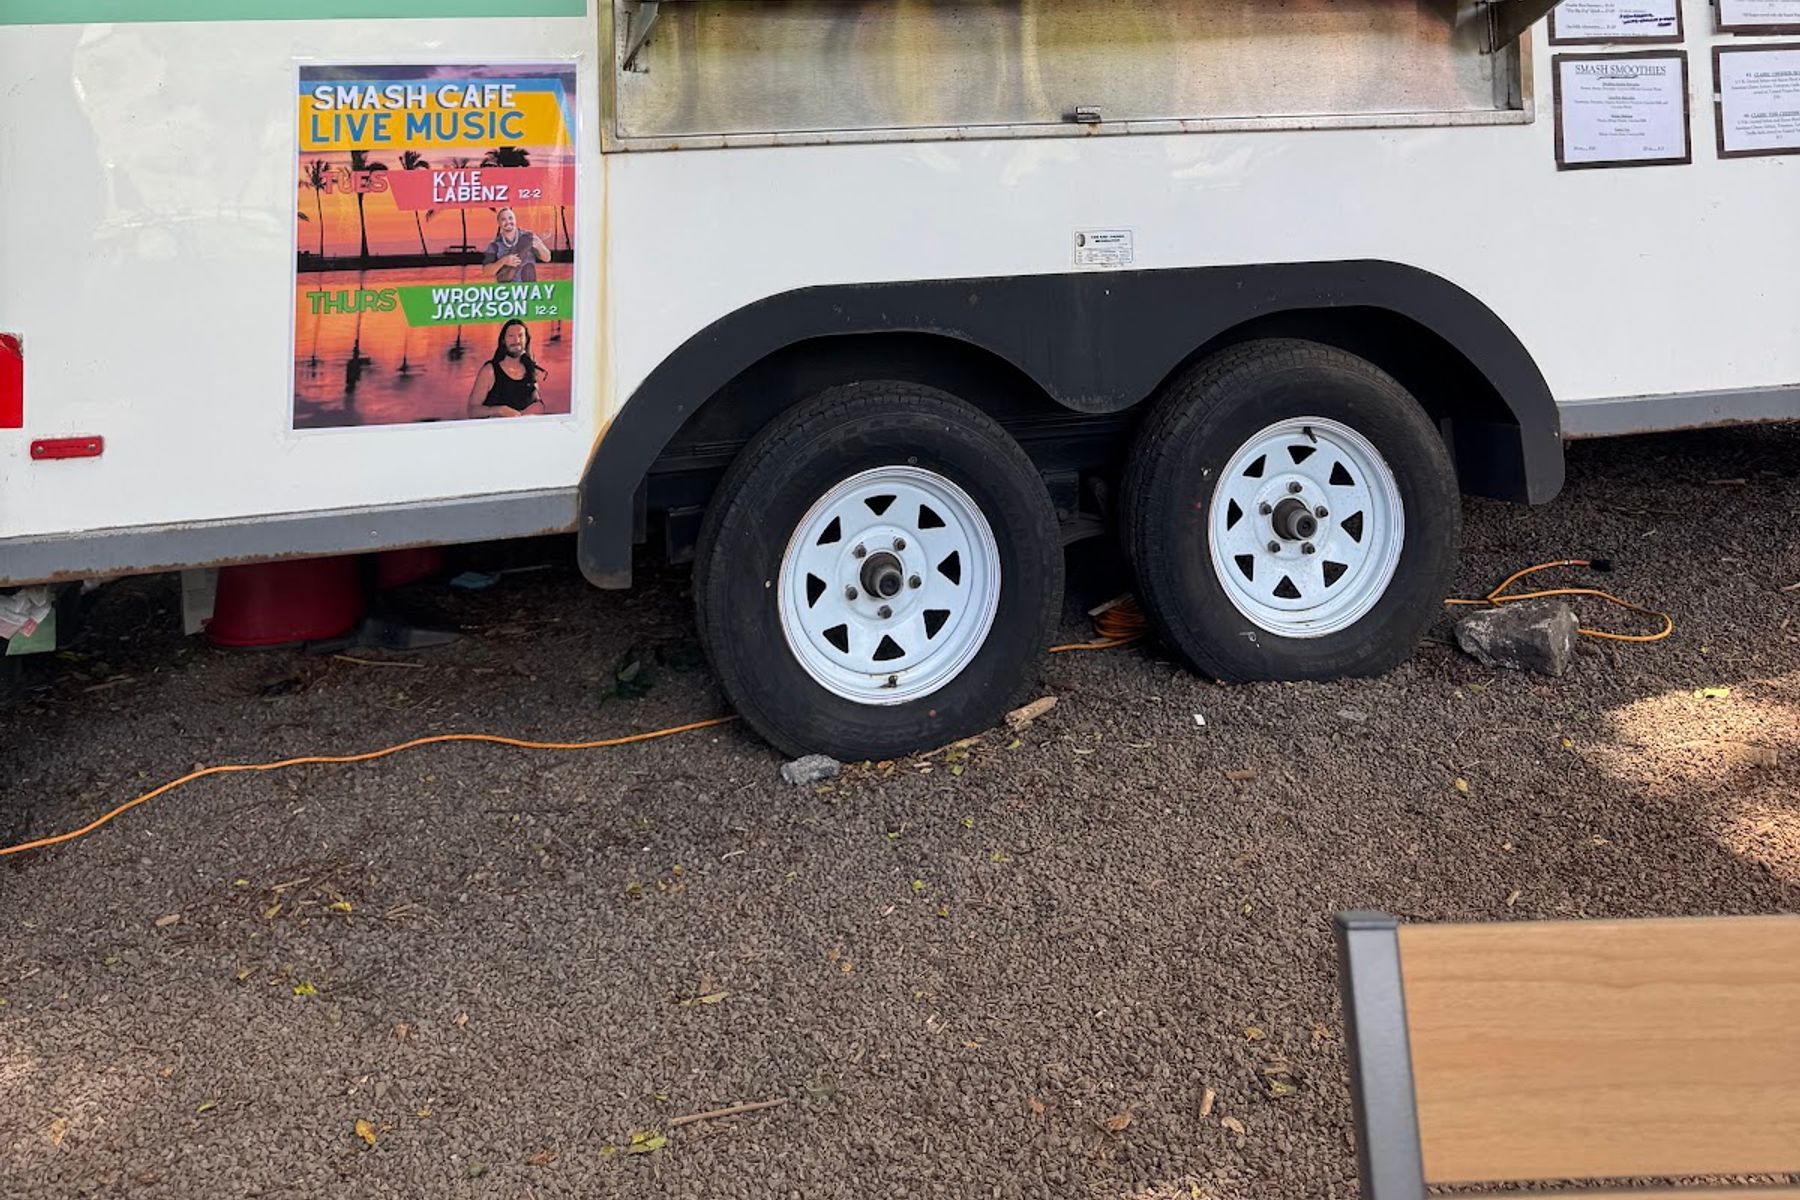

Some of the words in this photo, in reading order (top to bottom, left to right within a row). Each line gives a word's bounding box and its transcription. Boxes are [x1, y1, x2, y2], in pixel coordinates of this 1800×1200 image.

[1575, 64, 1608, 74] SMASH
[1609, 65, 1667, 76] SMOOTHIES
[312, 84, 428, 111] SMASH
[436, 83, 517, 109] CAFE
[312, 112, 392, 143] LIVE
[406, 111, 525, 141] MUSIC
[322, 169, 389, 195] TUES
[432, 171, 482, 188] KYLE
[432, 185, 509, 202] LABENZ
[306, 289, 399, 316] THURS
[431, 284, 556, 304] WRONGWAY
[431, 301, 528, 320] JACKSON
